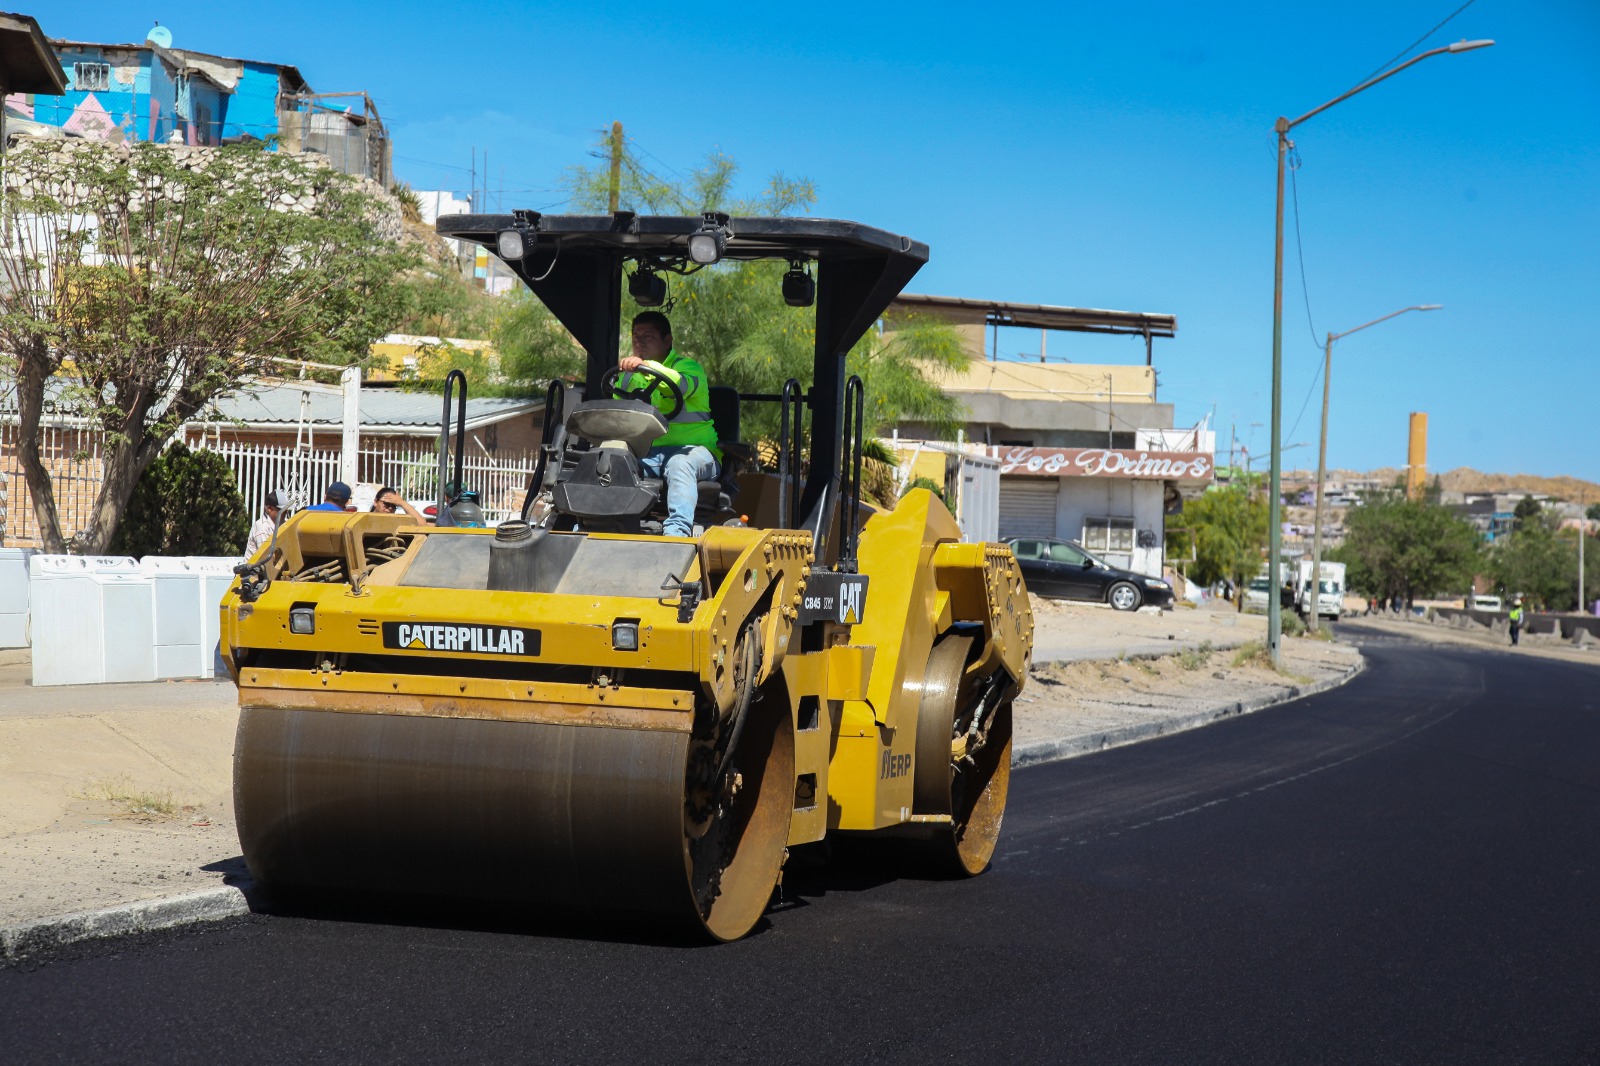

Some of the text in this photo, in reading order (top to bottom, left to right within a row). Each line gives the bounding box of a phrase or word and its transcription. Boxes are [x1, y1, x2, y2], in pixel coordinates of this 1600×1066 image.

[1001, 448, 1210, 477] Los Primos
[840, 582, 862, 623] CAT
[398, 624, 525, 654] CATERPILLAR
